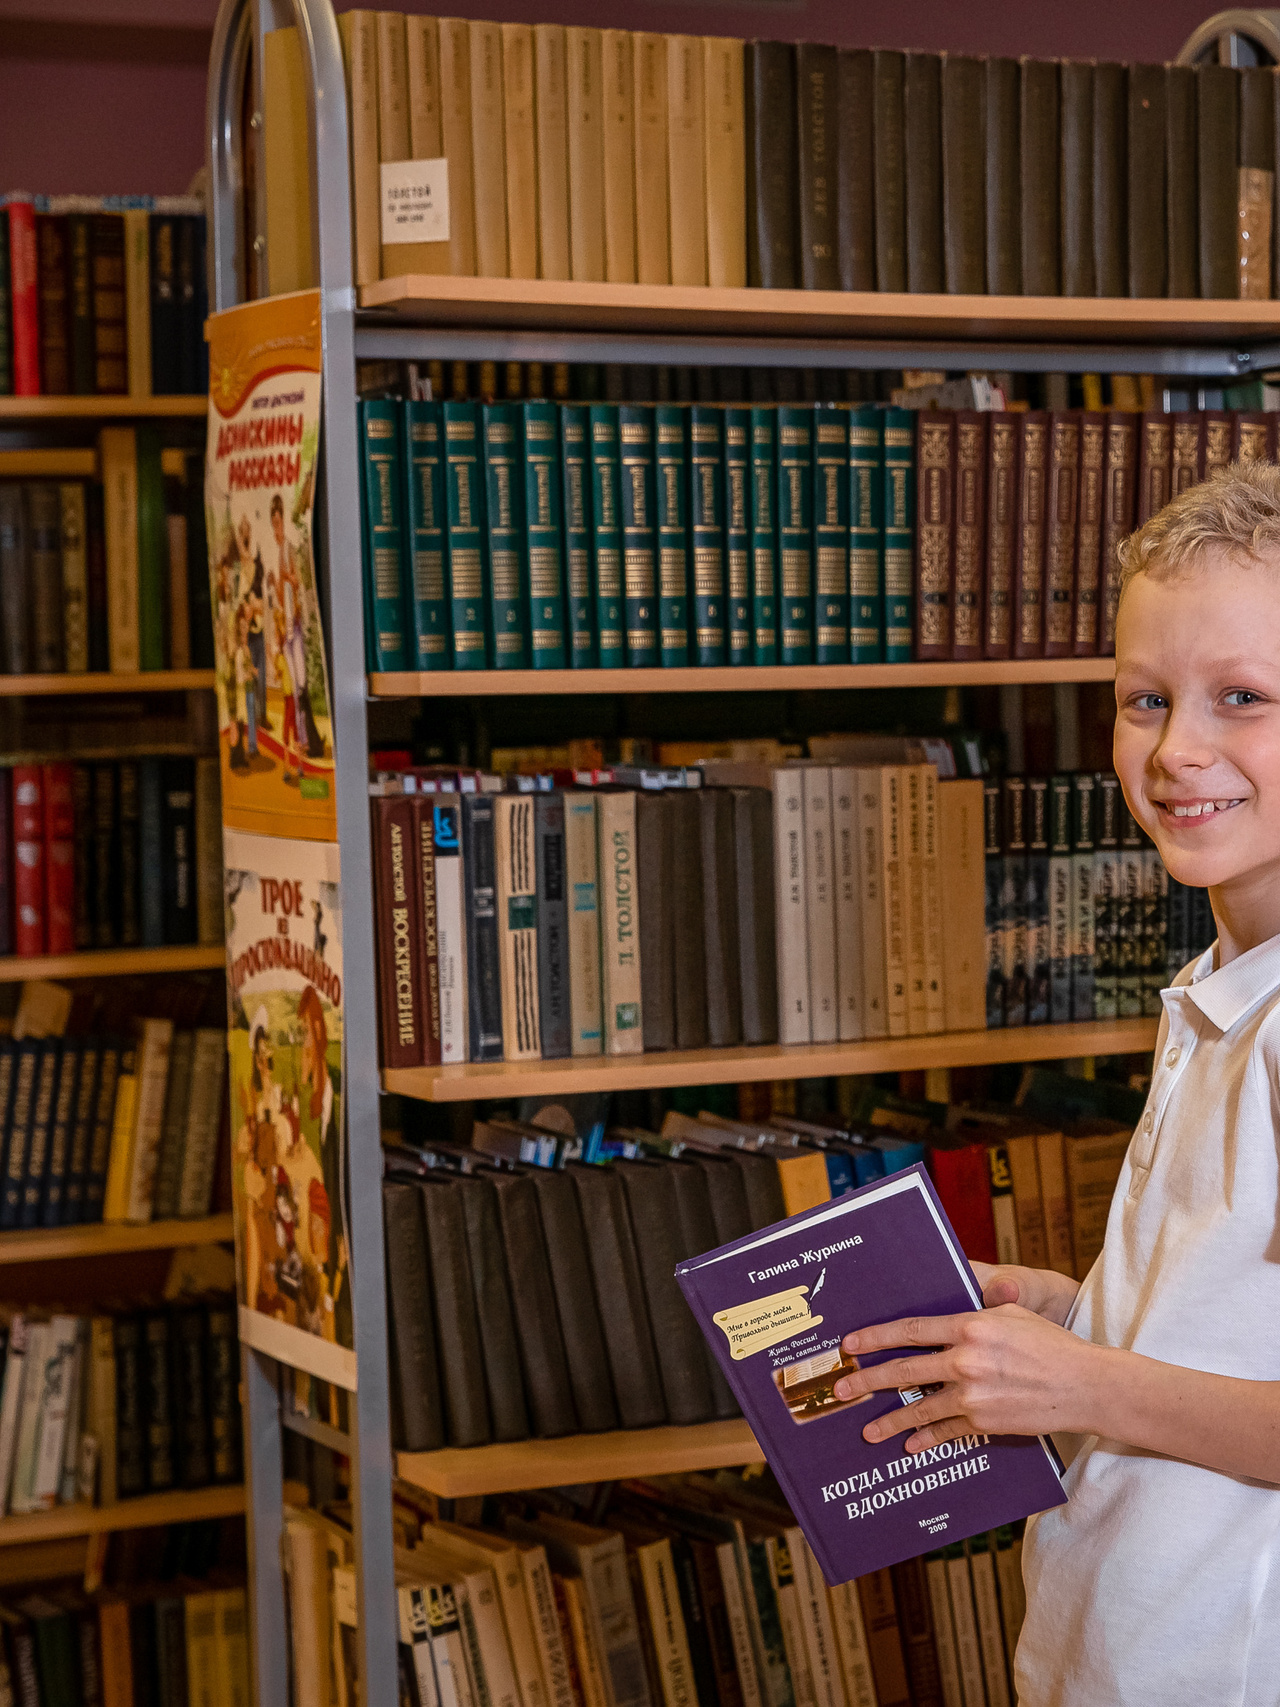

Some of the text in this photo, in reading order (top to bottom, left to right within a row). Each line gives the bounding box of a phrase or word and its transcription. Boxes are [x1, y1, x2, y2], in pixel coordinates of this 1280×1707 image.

[259, 878, 304, 917] ТРОЕ
[612, 830, 633, 942] ТОЛСТОЙ
[392, 908, 415, 1046] ВОСКРЕСЕНИЕ
[748, 1233, 863, 1285] Галина Журкина
[726, 1323, 743, 1334] Мне
[749, 1312, 772, 1326] городе
[773, 1304, 792, 1317] моём
[731, 1325, 770, 1343] Привольно
[767, 1333, 818, 1358] Живи, Россия!
[772, 1335, 842, 1367] Живи, святая Русь!
[820, 1467, 884, 1503] КОГДА
[845, 1454, 991, 1521] ВДОХНОВЕНИЕ
[918, 1511, 950, 1529] Москва
[928, 1521, 949, 1535] 2009
